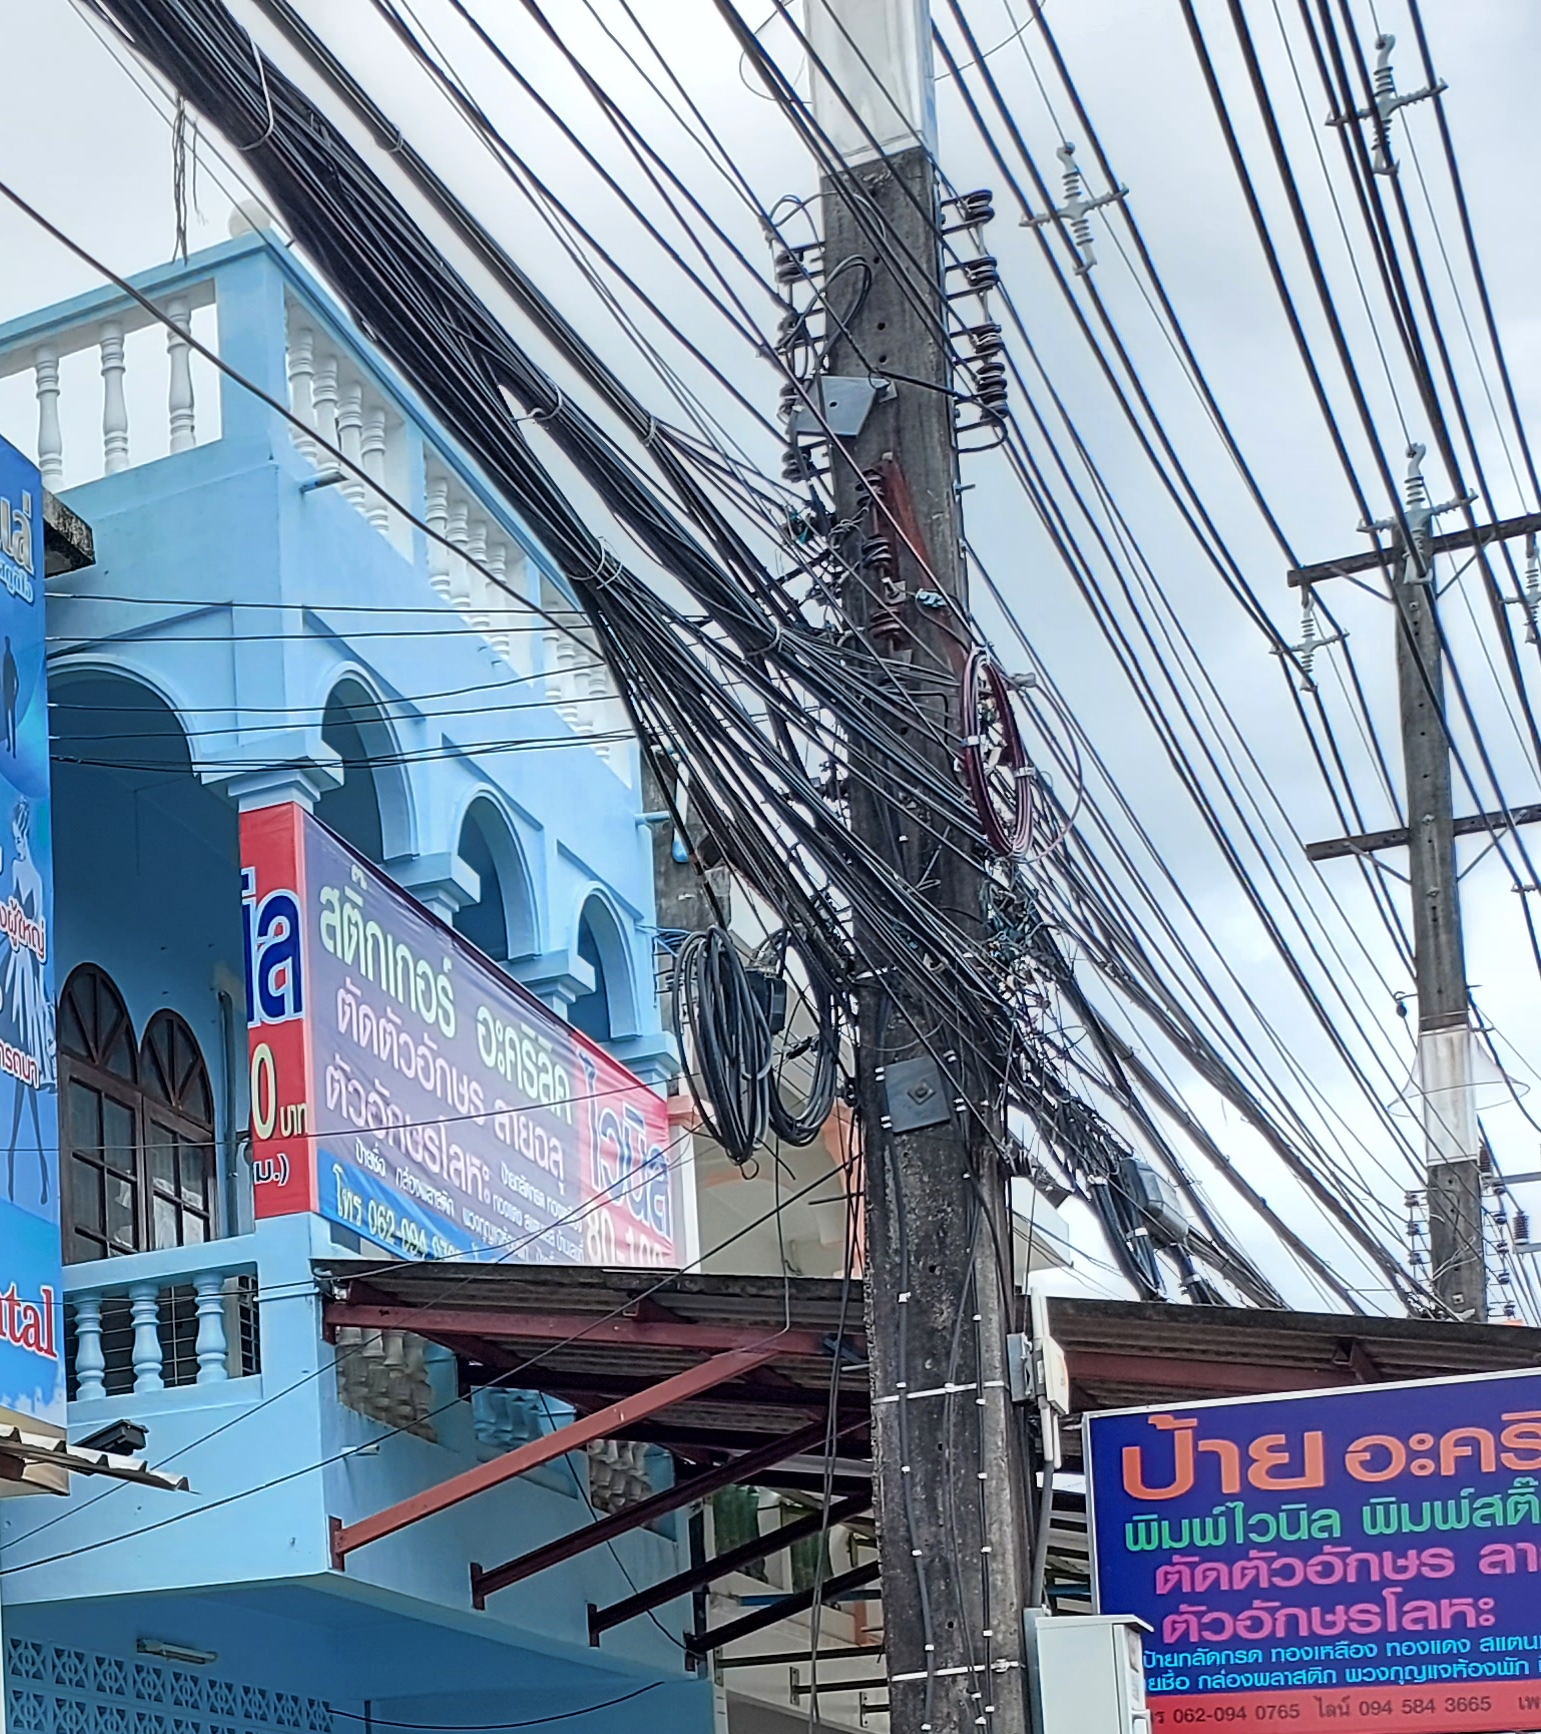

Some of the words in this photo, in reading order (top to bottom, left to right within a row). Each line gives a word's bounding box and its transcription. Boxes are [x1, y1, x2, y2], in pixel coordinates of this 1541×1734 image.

[336, 976, 485, 1126] ตัดตัวอักษร
[494, 1098, 565, 1196] ลายฉลุ
[325, 1052, 491, 1202] ตัวอักษรโลหะ
[333, 1163, 362, 1227] โทร
[1122, 1414, 1325, 1500] ป้าย
[1345, 1410, 1541, 1482] อะคริ
[1125, 1501, 1341, 1551] พิมพ์ไวนิล
[1362, 1476, 1541, 1536] พิมพ์สติ๊
[1156, 1545, 1455, 1595] ตัดตัวอักษร
[1478, 1542, 1541, 1575] ลา
[1162, 1586, 1496, 1644] ตัวอักษรโลหะ
[1144, 1669, 1190, 1692] ยชื่อ
[1198, 1666, 1337, 1690] กล่องพลาสติก
[1271, 1640, 1378, 1663] ทองเหลือง
[1386, 1638, 1471, 1657] ทองแดง
[1173, 1706, 1247, 1723] 062-094
[1255, 1703, 1300, 1720] 0765
[1314, 1696, 1350, 1718] ไลน์
[1359, 1699, 1392, 1716] 094
[1401, 1698, 1435, 1714] 584
[1444, 1696, 1492, 1713] 3665
